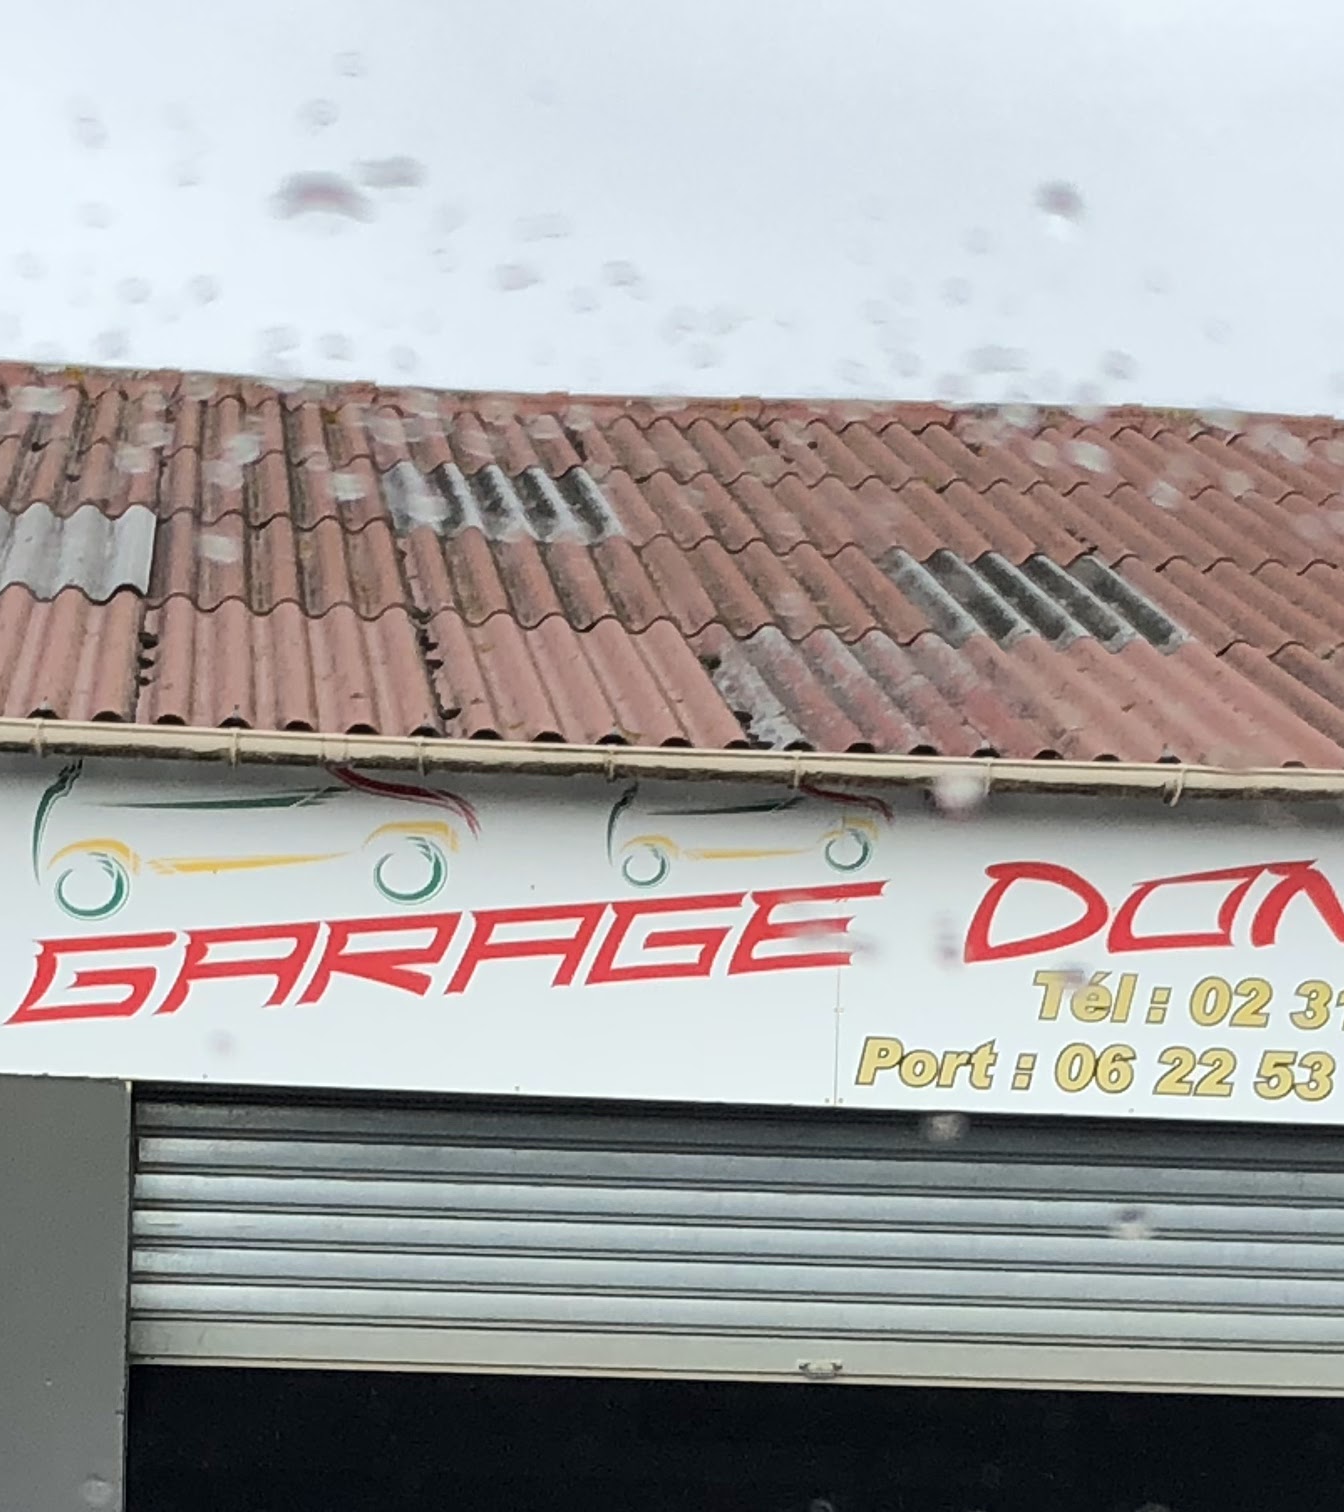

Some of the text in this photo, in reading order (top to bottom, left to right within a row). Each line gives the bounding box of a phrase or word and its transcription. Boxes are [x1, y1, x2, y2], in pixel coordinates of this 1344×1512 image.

[2, 880, 892, 1026] GARAGE
[1033, 970, 1139, 1024] Tél
[1189, 975, 1273, 1028] 02
[854, 1036, 999, 1091] Port
[1054, 1042, 1138, 1094] 06
[1152, 1046, 1237, 1097] 22
[1253, 1049, 1336, 1101] 53
